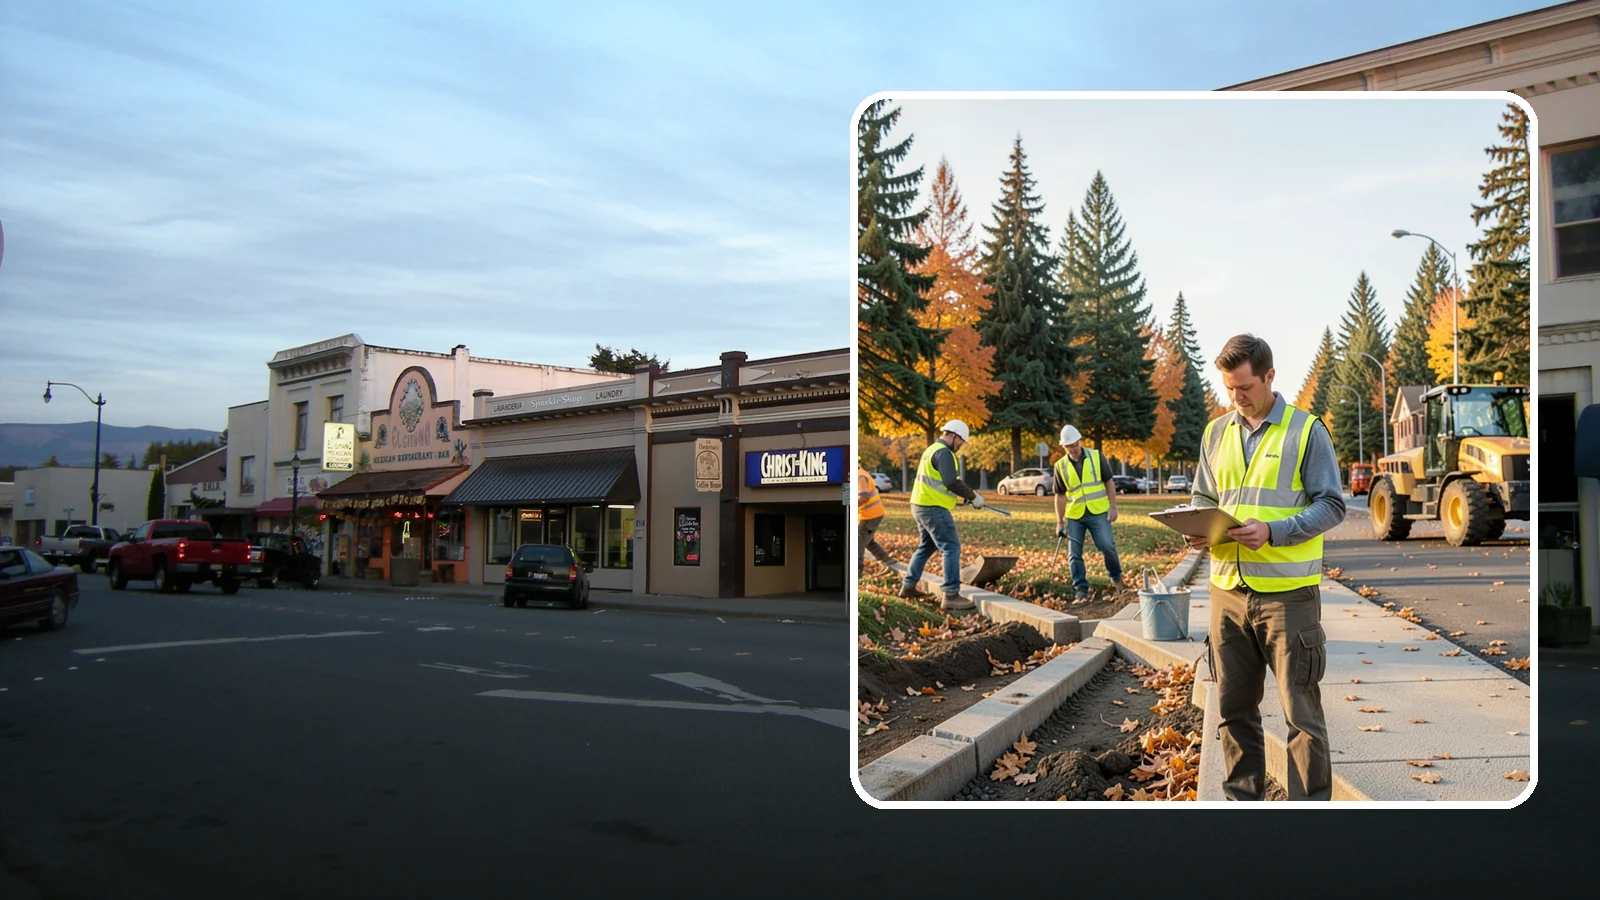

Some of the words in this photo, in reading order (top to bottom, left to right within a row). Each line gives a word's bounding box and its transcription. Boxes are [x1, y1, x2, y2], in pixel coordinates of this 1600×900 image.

[562, 394, 582, 404] Shop
[595, 389, 623, 400] LAUNDRY
[493, 402, 522, 413] LAVANDERIA
[373, 454, 396, 464] MEXICAN
[397, 451, 433, 462] RESTAURANT
[437, 450, 450, 459] BAR
[761, 452, 797, 478] CHRIST
[799, 450, 827, 476] KING
